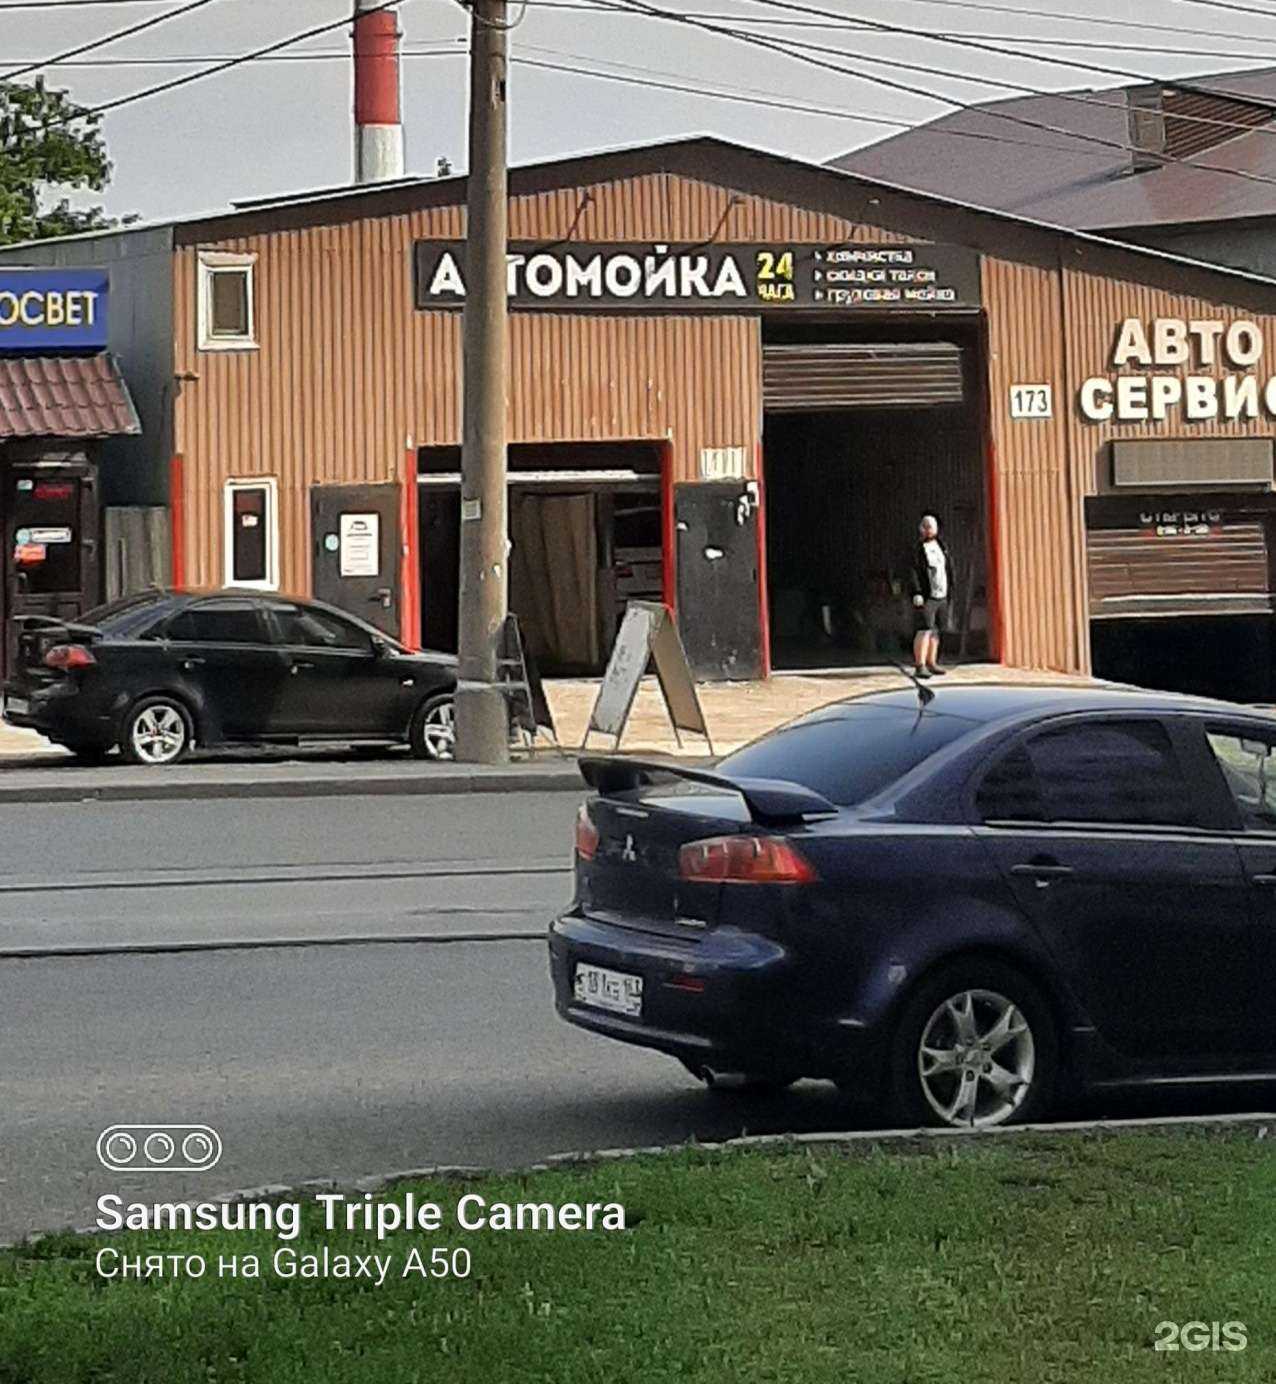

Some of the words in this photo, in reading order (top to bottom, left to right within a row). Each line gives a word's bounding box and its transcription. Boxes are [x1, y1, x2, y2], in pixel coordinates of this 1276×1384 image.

[429, 245, 747, 297] АТОМОЙКА
[757, 252, 793, 280] 24
[1113, 318, 1264, 366] АВТО
[1014, 390, 1048, 413] 173
